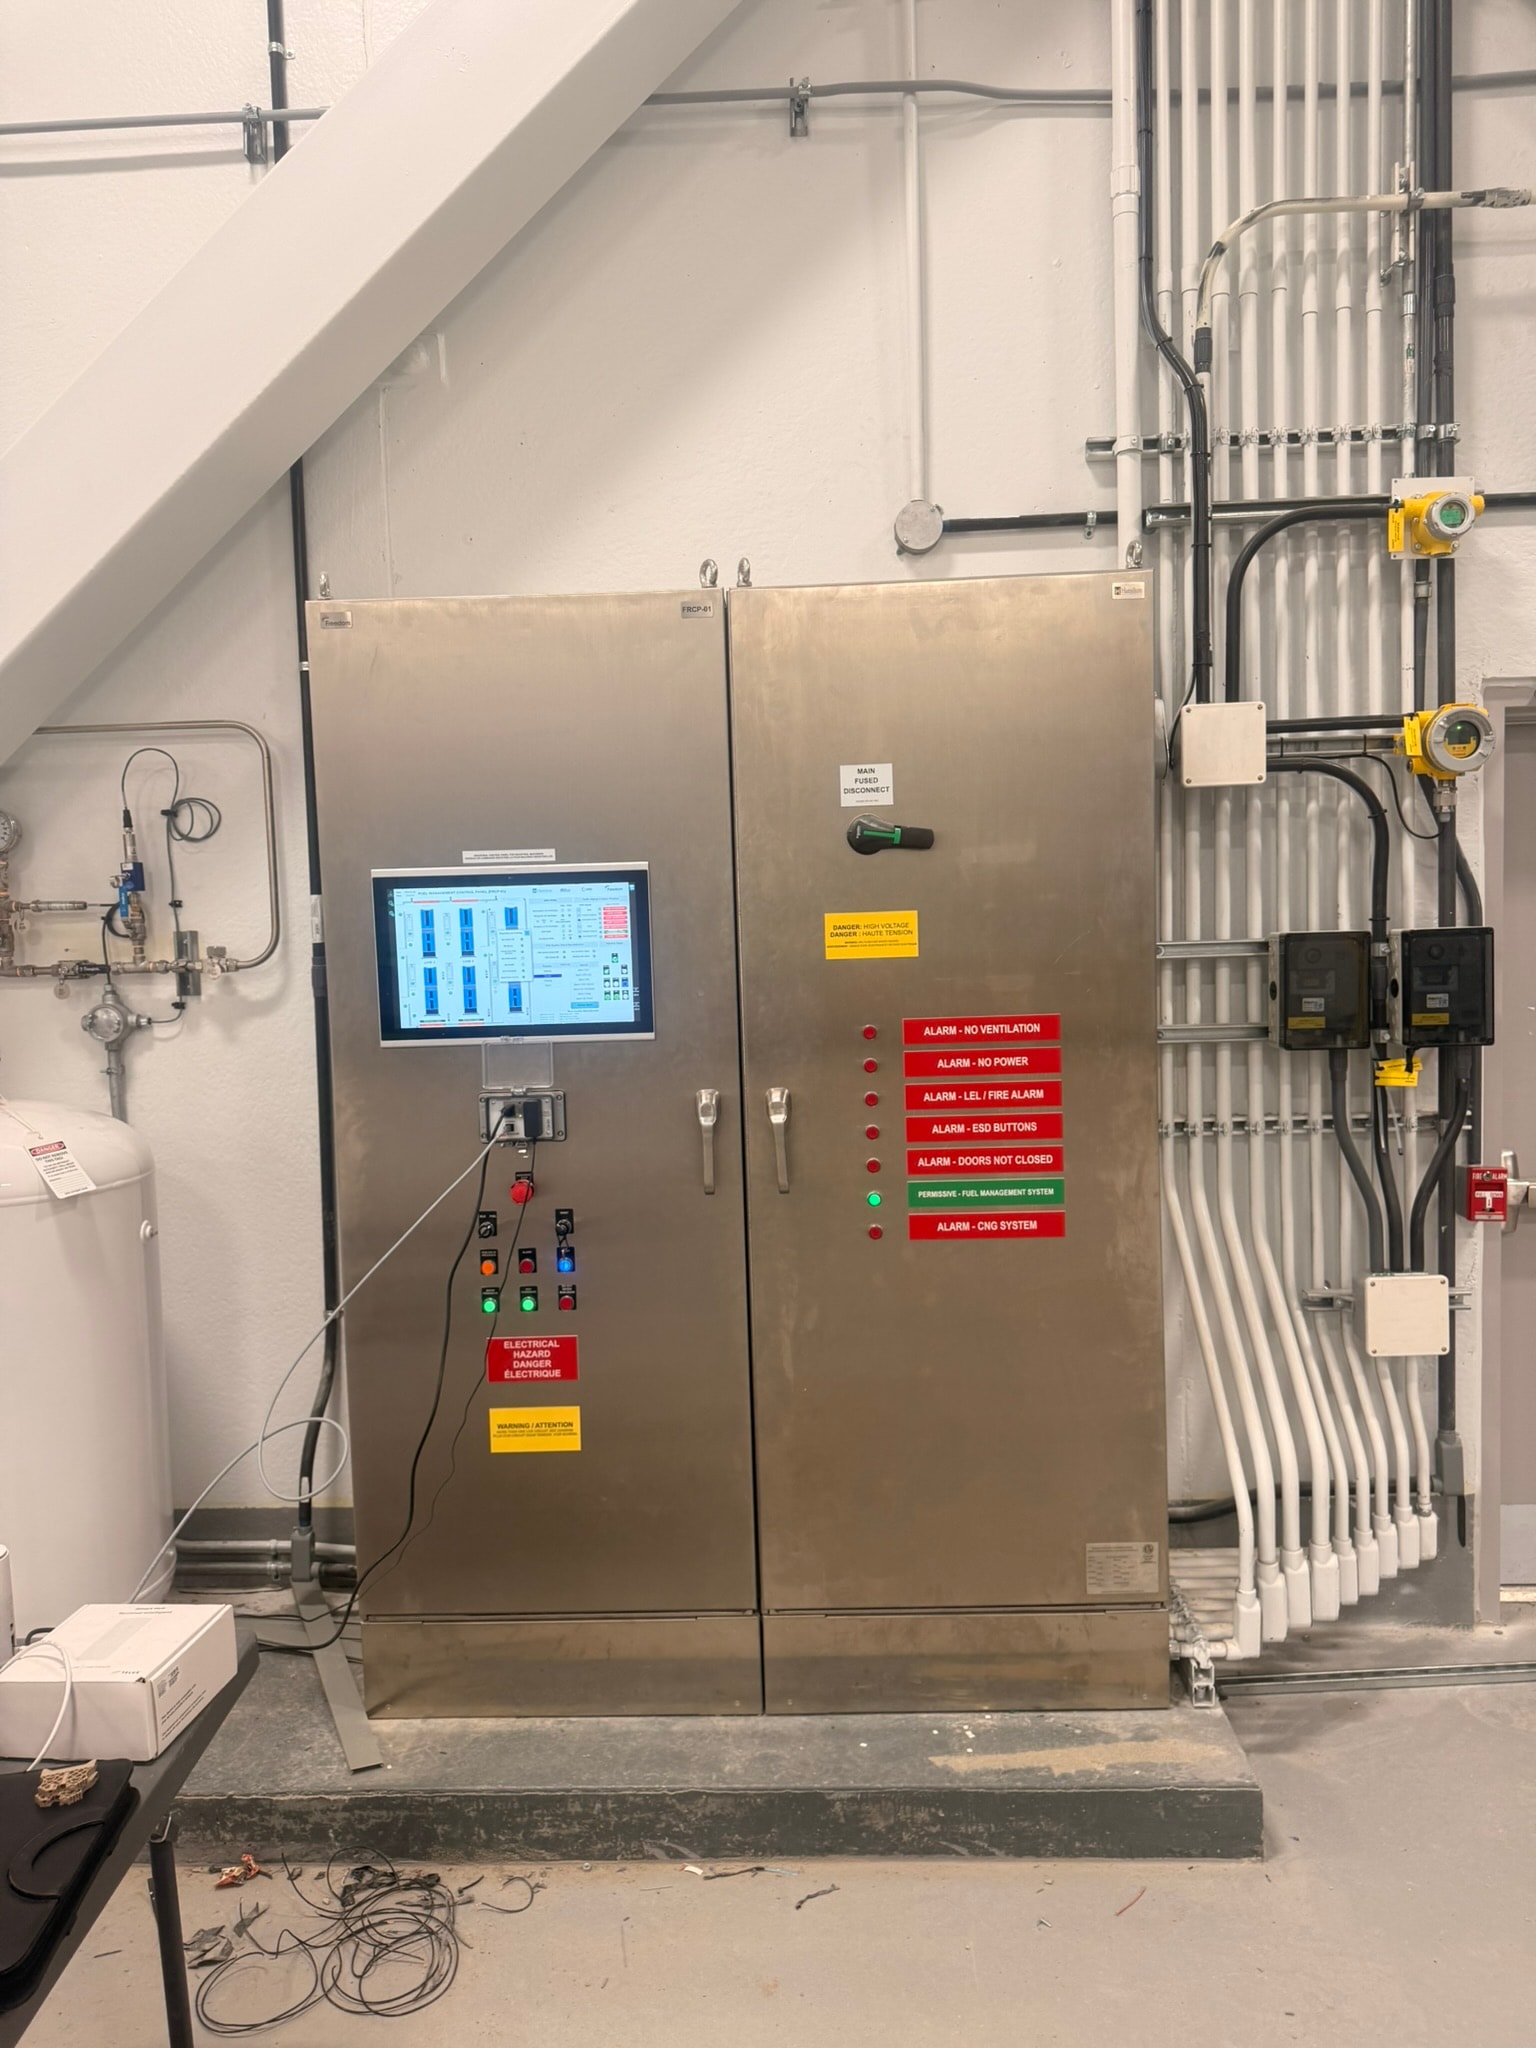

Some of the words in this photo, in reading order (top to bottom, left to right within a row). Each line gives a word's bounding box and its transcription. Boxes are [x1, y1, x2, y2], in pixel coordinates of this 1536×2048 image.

[854, 777, 879, 785] FUSED
[843, 786, 890, 795] DISCONNECT
[832, 923, 862, 932] DANGER:
[863, 922, 880, 930] HIGH
[880, 921, 910, 930] VOLTAGE
[830, 930, 858, 938] DANGER
[862, 929, 884, 938] HAUTE
[885, 928, 913, 937] TENSION
[924, 1025, 957, 1036] ALARM
[964, 1025, 979, 1035] NO
[981, 1023, 1041, 1034] VENTILATION
[937, 1058, 970, 1069] ALARM
[978, 1057, 992, 1067] NO
[994, 1056, 1029, 1066] POWER
[923, 1091, 957, 1102] ALARM
[964, 1091, 981, 1101] LEL
[983, 1090, 987, 1100] /
[988, 1090, 1009, 1100] FIRE
[1011, 1089, 1044, 1099] ALARM
[932, 1124, 965, 1134] ALARM
[972, 1123, 991, 1133] ESD
[993, 1122, 1037, 1132] BUTTONS
[918, 1157, 951, 1167] ALARM
[958, 1156, 991, 1166] DOORS
[993, 1155, 1013, 1165] NOT
[1015, 1154, 1053, 1165] CLOSED
[918, 1190, 957, 1198] PERMISSIVE
[962, 1189, 978, 1197] FUEL
[980, 1188, 1026, 1197] MANAGEMENT
[1027, 1188, 1054, 1196] SYSTEM
[937, 1222, 970, 1232] ALARM
[978, 1221, 998, 1231] CNG
[1000, 1220, 1038, 1230] SYSTEM
[503, 1340, 560, 1349] ELECTRICAL
[513, 1350, 551, 1359] HAZARD
[513, 1360, 552, 1369] DANGER
[504, 1369, 561, 1379] ÉLECTRIQUE
[497, 1422, 530, 1430] WARNING
[535, 1421, 574, 1429] ATTENTION
